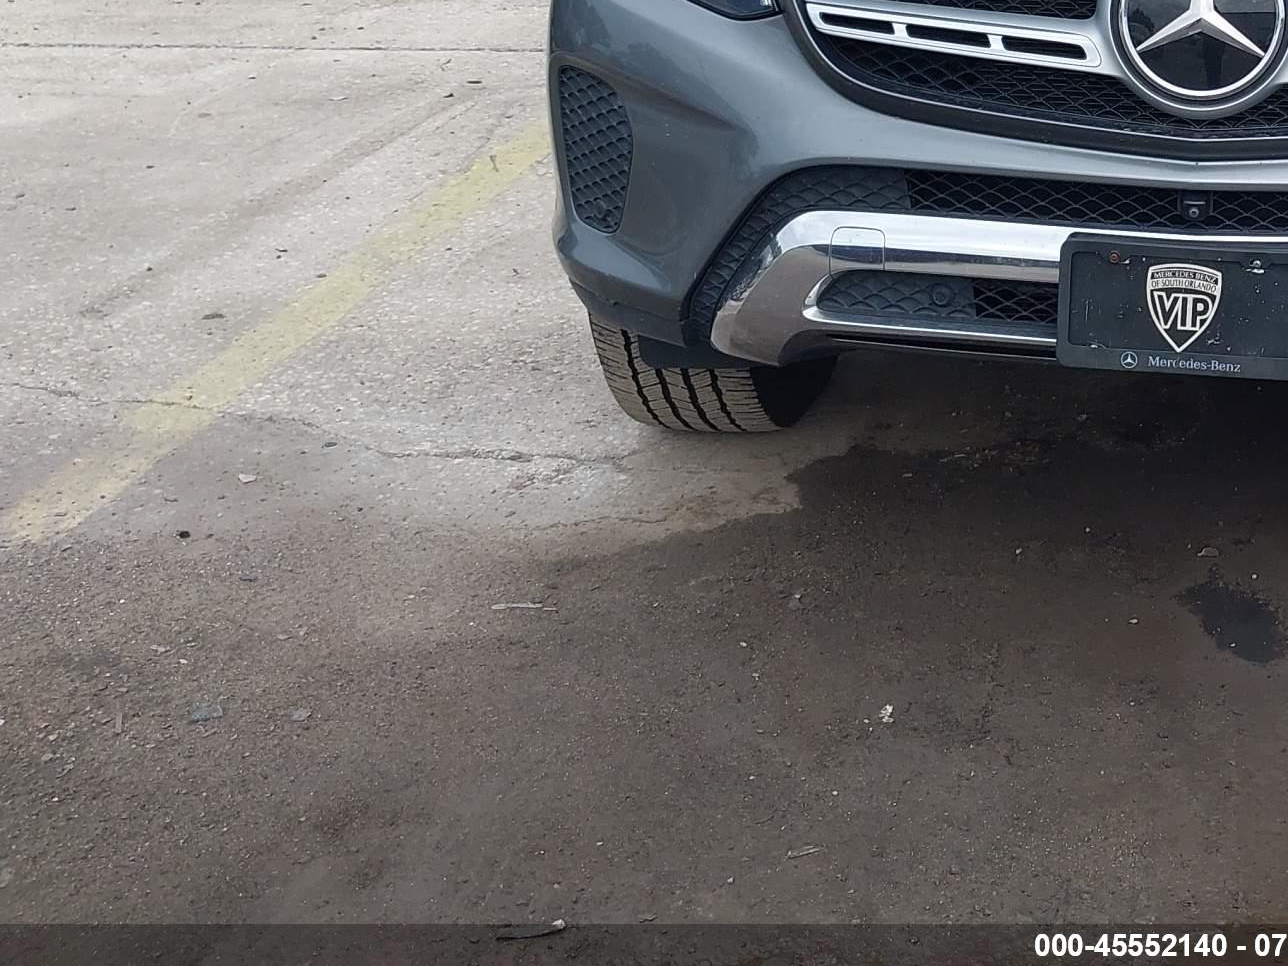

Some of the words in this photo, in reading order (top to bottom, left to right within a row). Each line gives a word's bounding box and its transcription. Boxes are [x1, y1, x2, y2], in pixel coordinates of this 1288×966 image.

[1153, 270, 1194, 279] MERCEDES
[1195, 273, 1217, 284] BENZ
[1151, 280, 1160, 288] OF
[1161, 279, 1184, 287] SOUTH
[1184, 280, 1217, 293] ORLANDO
[1153, 291, 1212, 331] VIP
[1148, 356, 1241, 373] Mercedes-Benz
